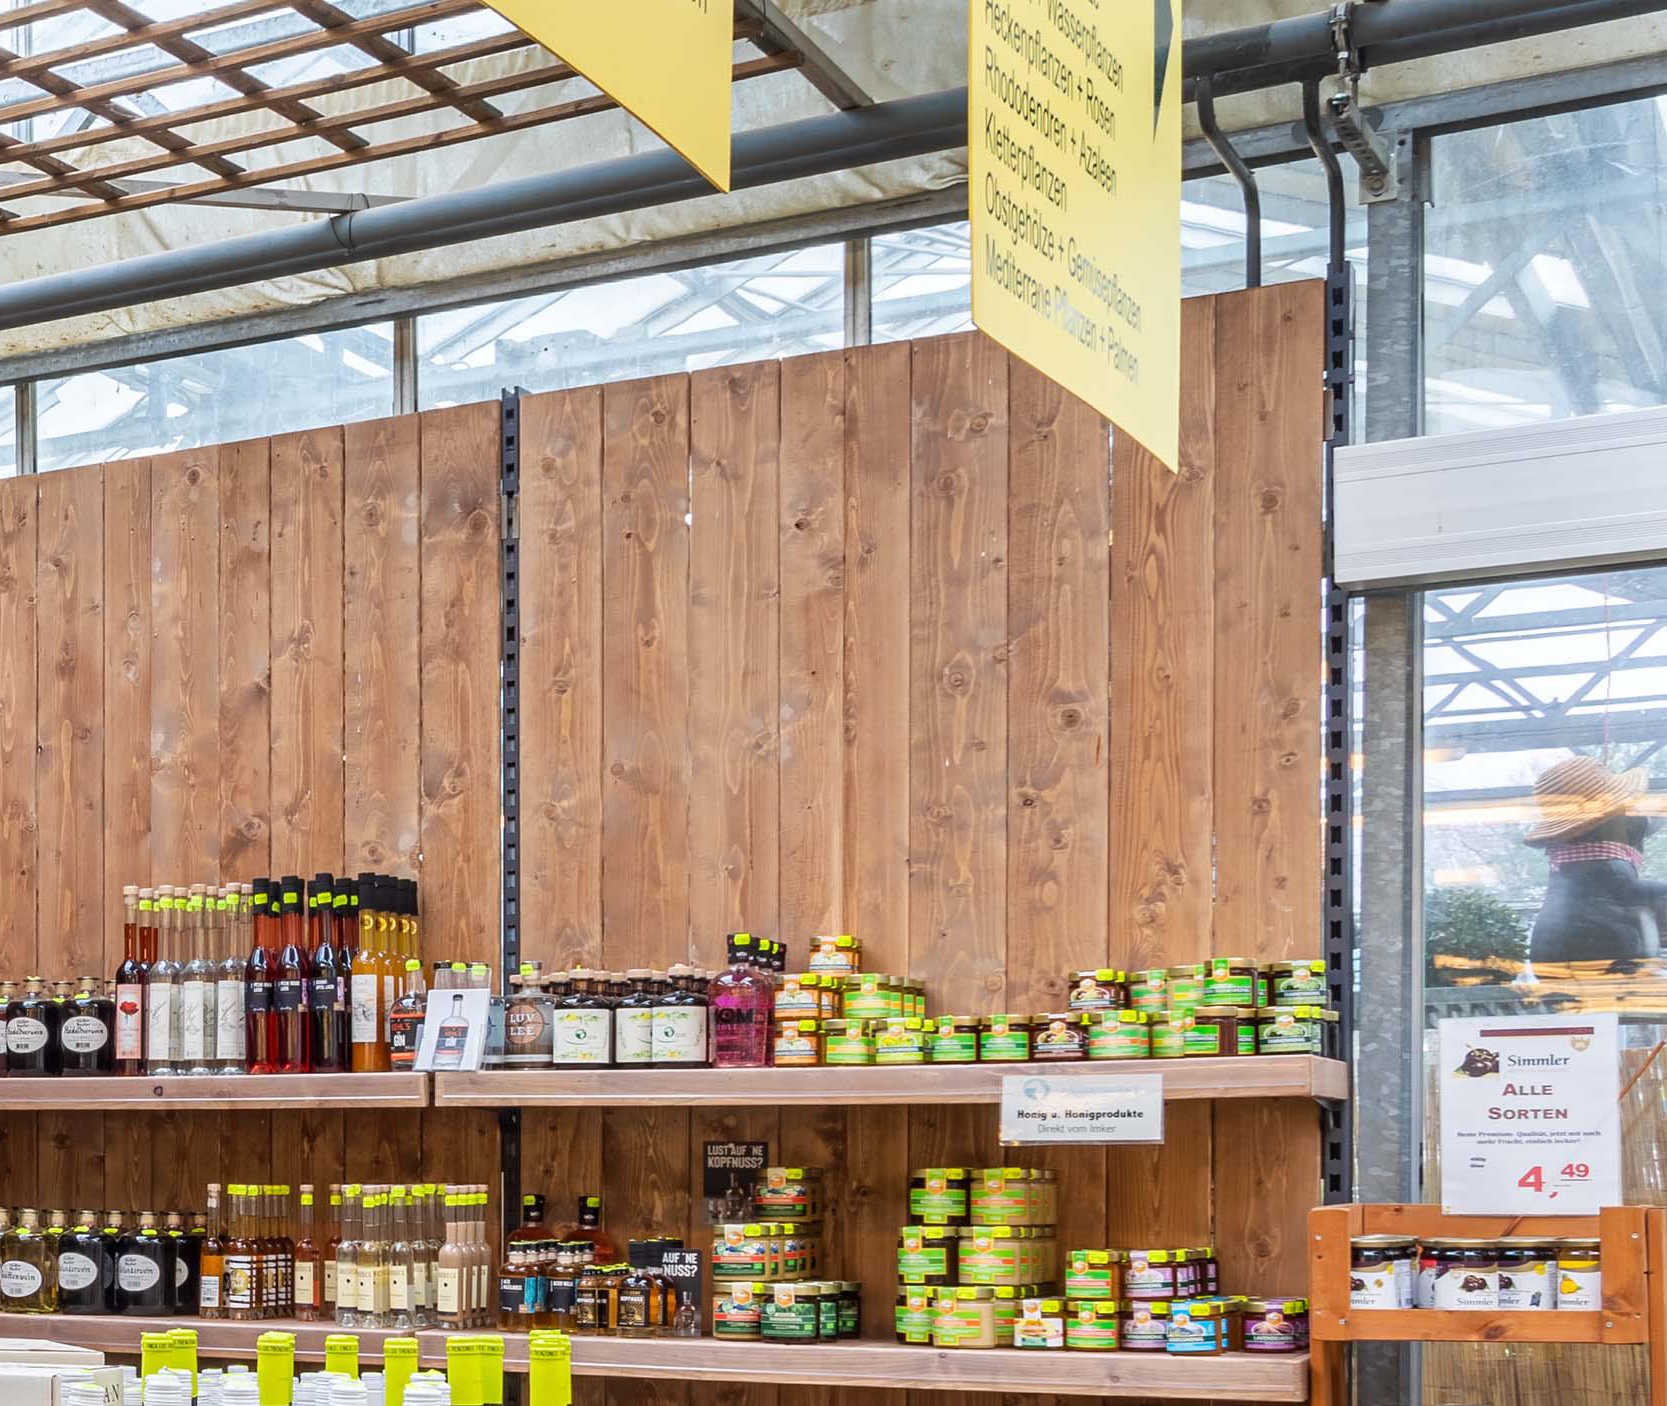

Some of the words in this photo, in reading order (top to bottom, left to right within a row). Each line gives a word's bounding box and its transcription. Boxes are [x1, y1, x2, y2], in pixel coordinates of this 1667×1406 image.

[1086, 77, 1116, 141] Rosen
[985, 45, 1067, 153] Rhododendren
[1079, 131, 1116, 196] Azaleen
[985, 107, 1067, 212] Kletterpflanzen
[985, 171, 1055, 262] Obstgehölze
[1068, 236, 1141, 334] Gemüsepflanzen
[985, 233, 1051, 319] Mediterrane
[509, 1013, 536, 1024] LUV
[509, 1027, 535, 1038] LEE
[1507, 1053, 1570, 1067] Simmler
[1502, 1083, 1553, 1096] ALLE
[1065, 1108, 1144, 1121] Honigprodukte
[1488, 1107, 1568, 1120] SORTEN
[1037, 1124, 1065, 1134] Direkt
[1090, 1124, 1116, 1133] Imker
[708, 1144, 729, 1155] LUST
[731, 1145, 747, 1156] AUF
[708, 1156, 763, 1169] KOPFNUSS?
